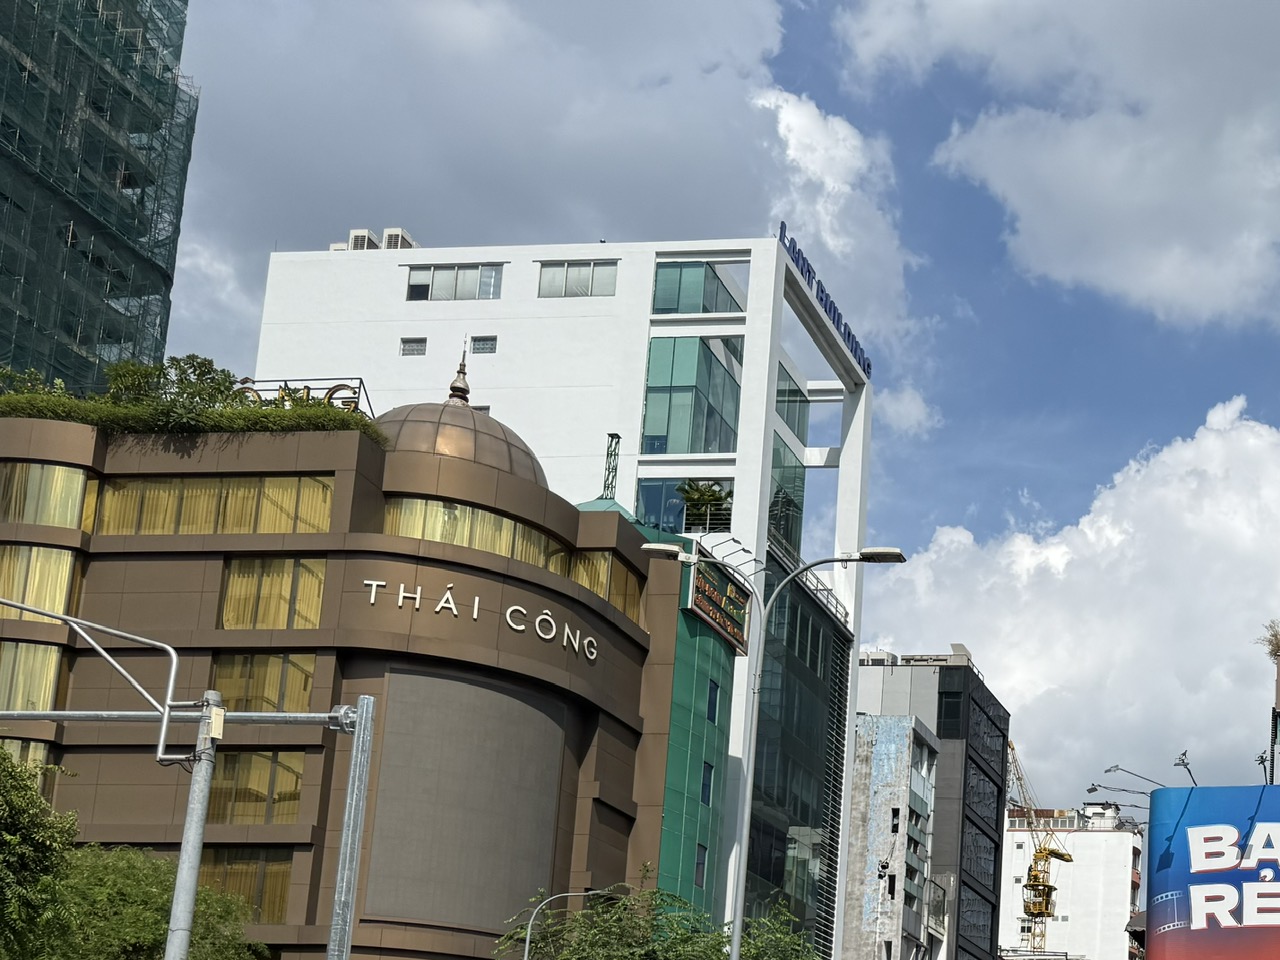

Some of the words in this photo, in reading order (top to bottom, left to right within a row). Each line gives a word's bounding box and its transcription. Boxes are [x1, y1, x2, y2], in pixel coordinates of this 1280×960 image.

[816, 279, 872, 379] BUILDING
[363, 580, 479, 620] THÁI
[505, 605, 598, 660] CÔNG
